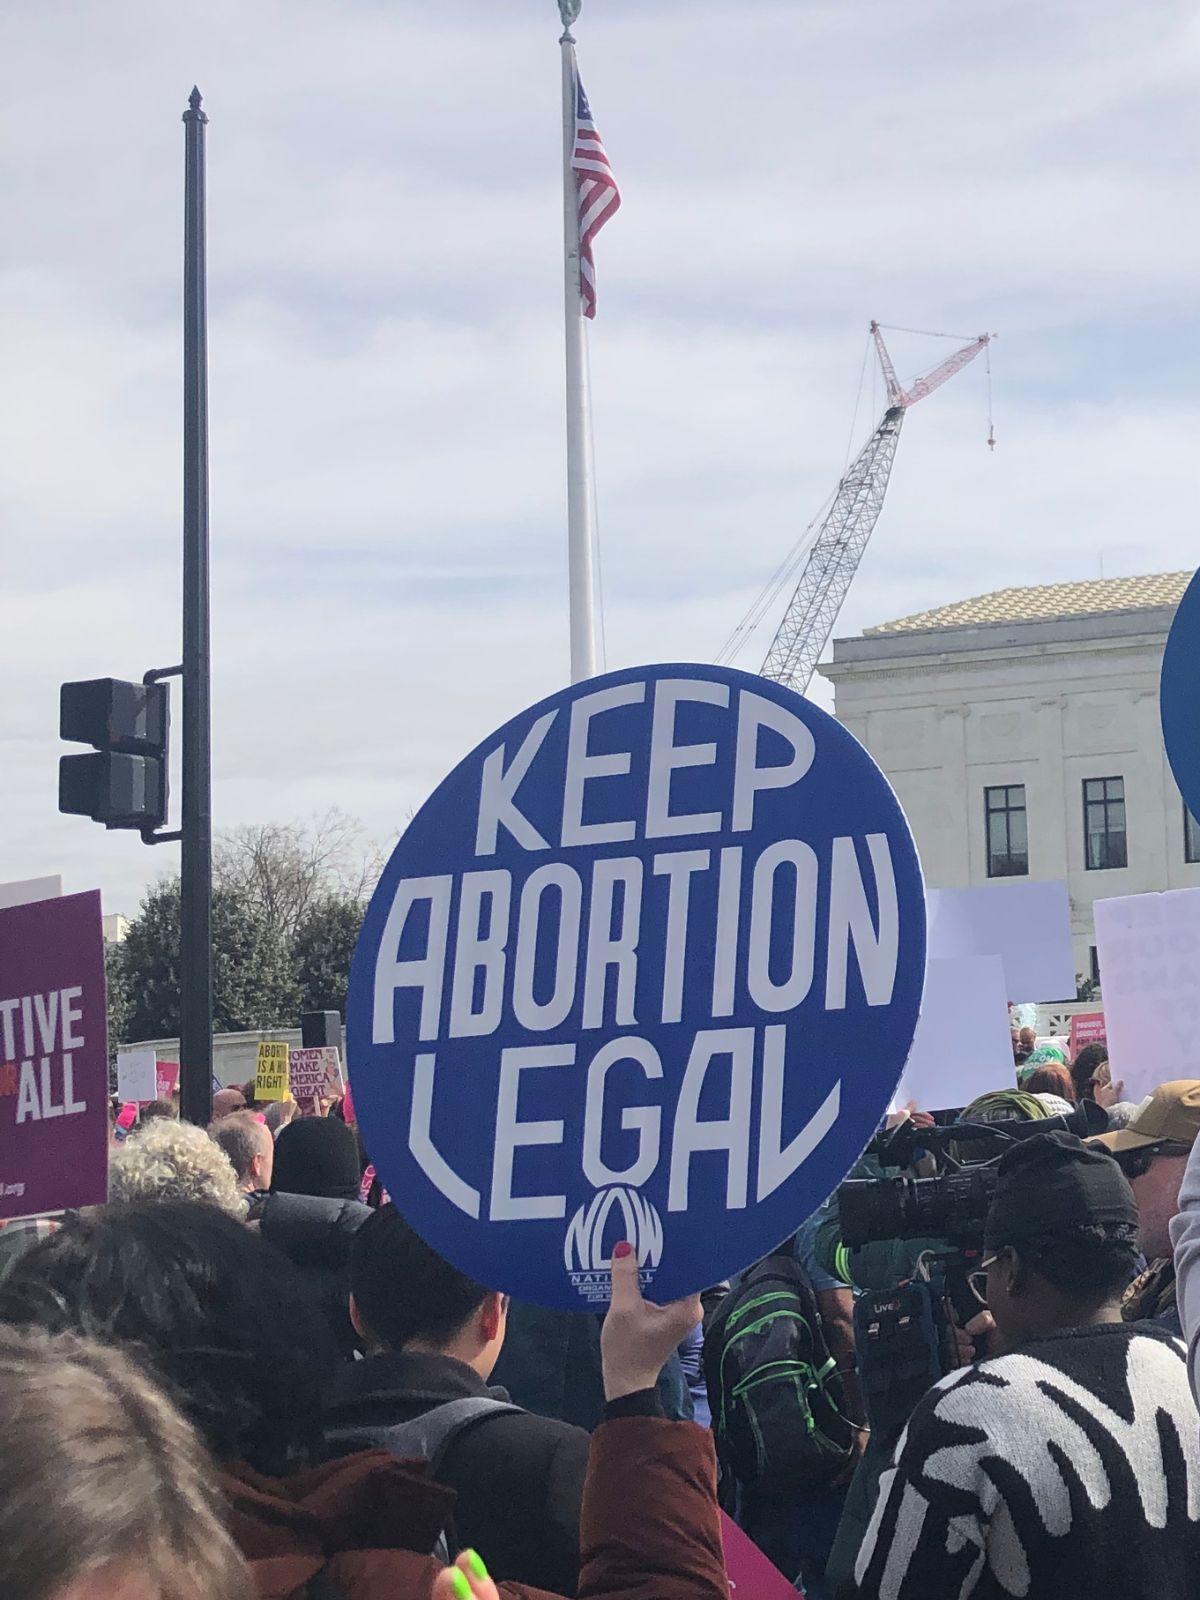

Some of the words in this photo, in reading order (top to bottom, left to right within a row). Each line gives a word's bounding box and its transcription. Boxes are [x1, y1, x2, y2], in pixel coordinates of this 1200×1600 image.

[474, 678, 816, 857] KEEP
[372, 832, 899, 1045] ABORTION
[0, 985, 86, 1061] TIVE
[16, 1052, 87, 1124] ALL
[256, 1075, 283, 1089] RIGHT
[290, 1061, 319, 1073] MAKE
[408, 1025, 841, 1222] LEGAL
[563, 1186, 664, 1272] NOW
